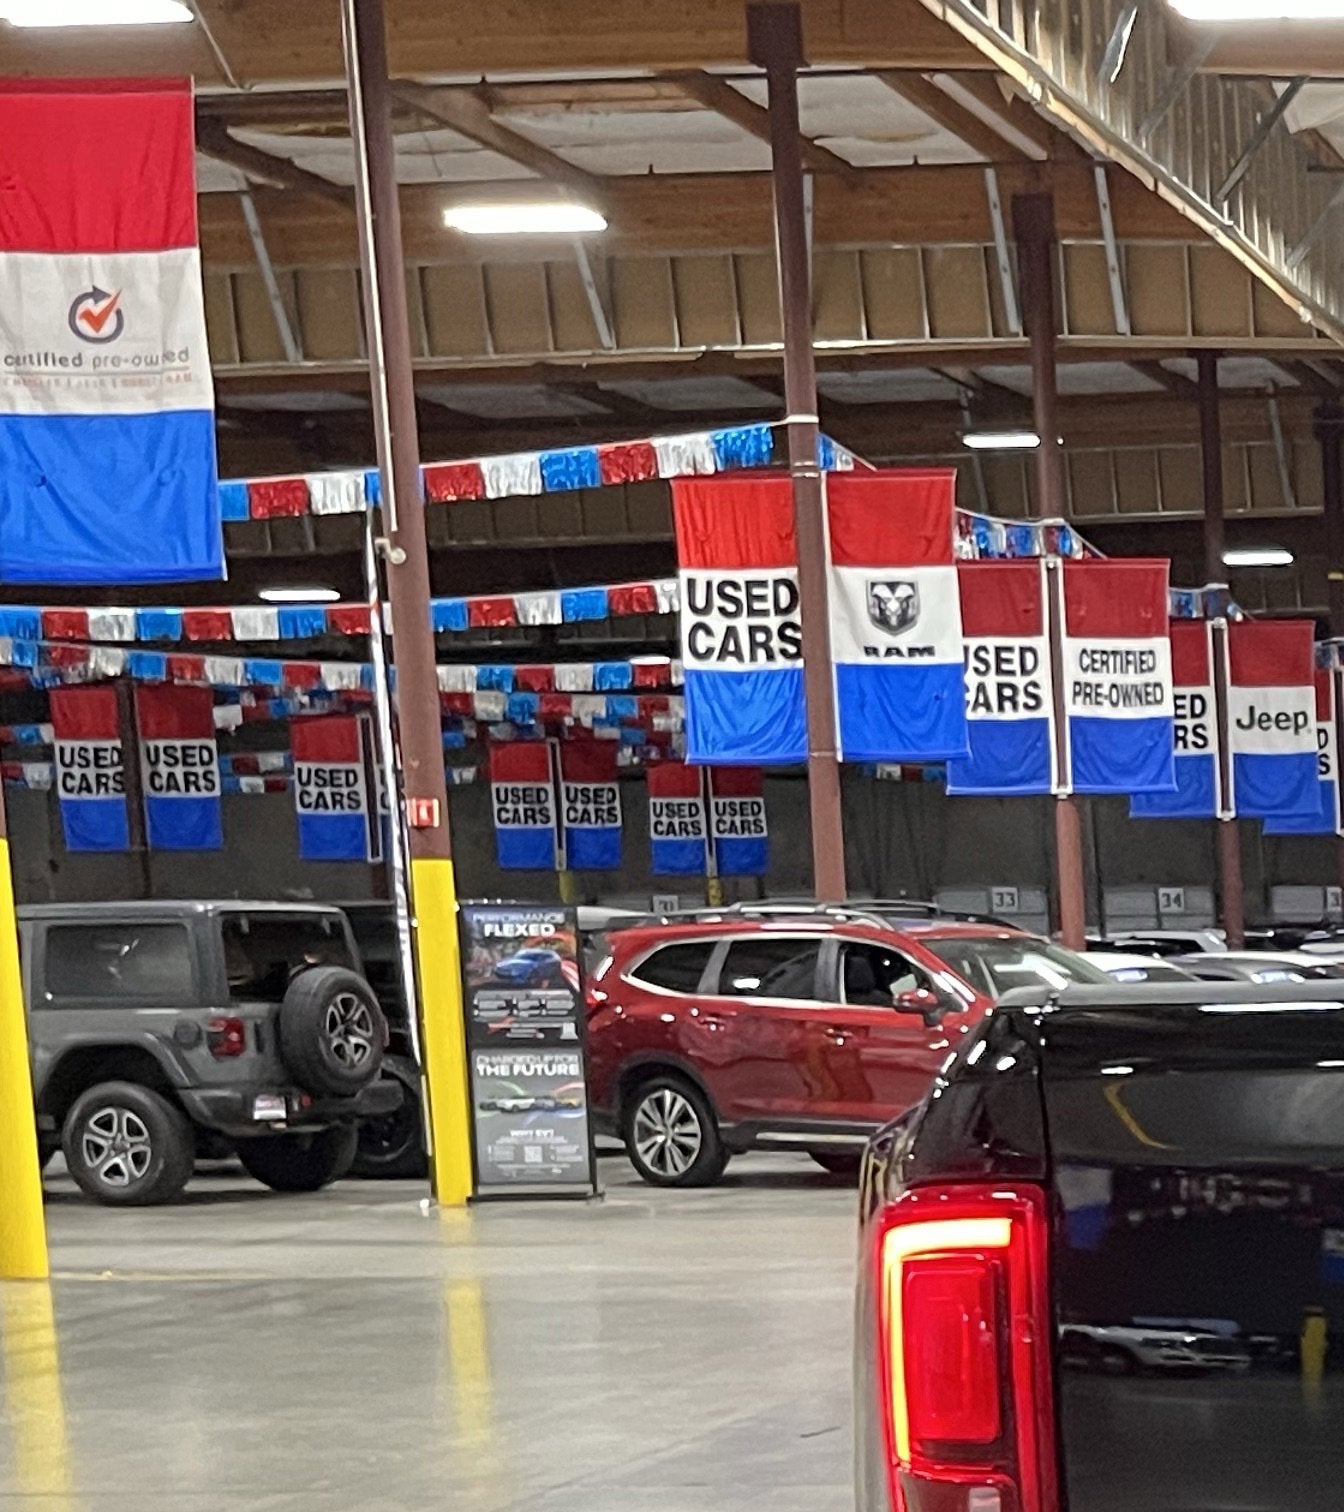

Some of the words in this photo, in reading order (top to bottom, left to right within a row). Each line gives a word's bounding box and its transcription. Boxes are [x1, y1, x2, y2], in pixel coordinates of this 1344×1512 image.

[687, 578, 799, 618] USED
[688, 621, 802, 663] CARS
[864, 645, 936, 658] RAM
[1079, 648, 1156, 675] CERTIFIED
[965, 680, 1044, 713] ARS
[1072, 681, 1164, 708] PRE-OWNED
[1174, 694, 1207, 720] ED
[1236, 705, 1308, 736] Jeep
[1174, 723, 1209, 749] RS
[59, 745, 122, 769] USED
[146, 744, 214, 768] USED
[61, 771, 124, 795] CARS
[150, 770, 216, 793] CARS
[298, 767, 358, 788] USED
[299, 790, 361, 811] CARS
[495, 786, 549, 805] USED
[565, 786, 616, 804] USED
[496, 806, 551, 825] CARS
[566, 806, 618, 825] CARS
[652, 801, 699, 818] USED
[714, 800, 761, 817] USED
[653, 820, 702, 837] CARS
[715, 818, 764, 835] CARS
[484, 923, 555, 937] FLEXED
[478, 1064, 510, 1076] THE
[513, 1063, 579, 1076] FUTURE
